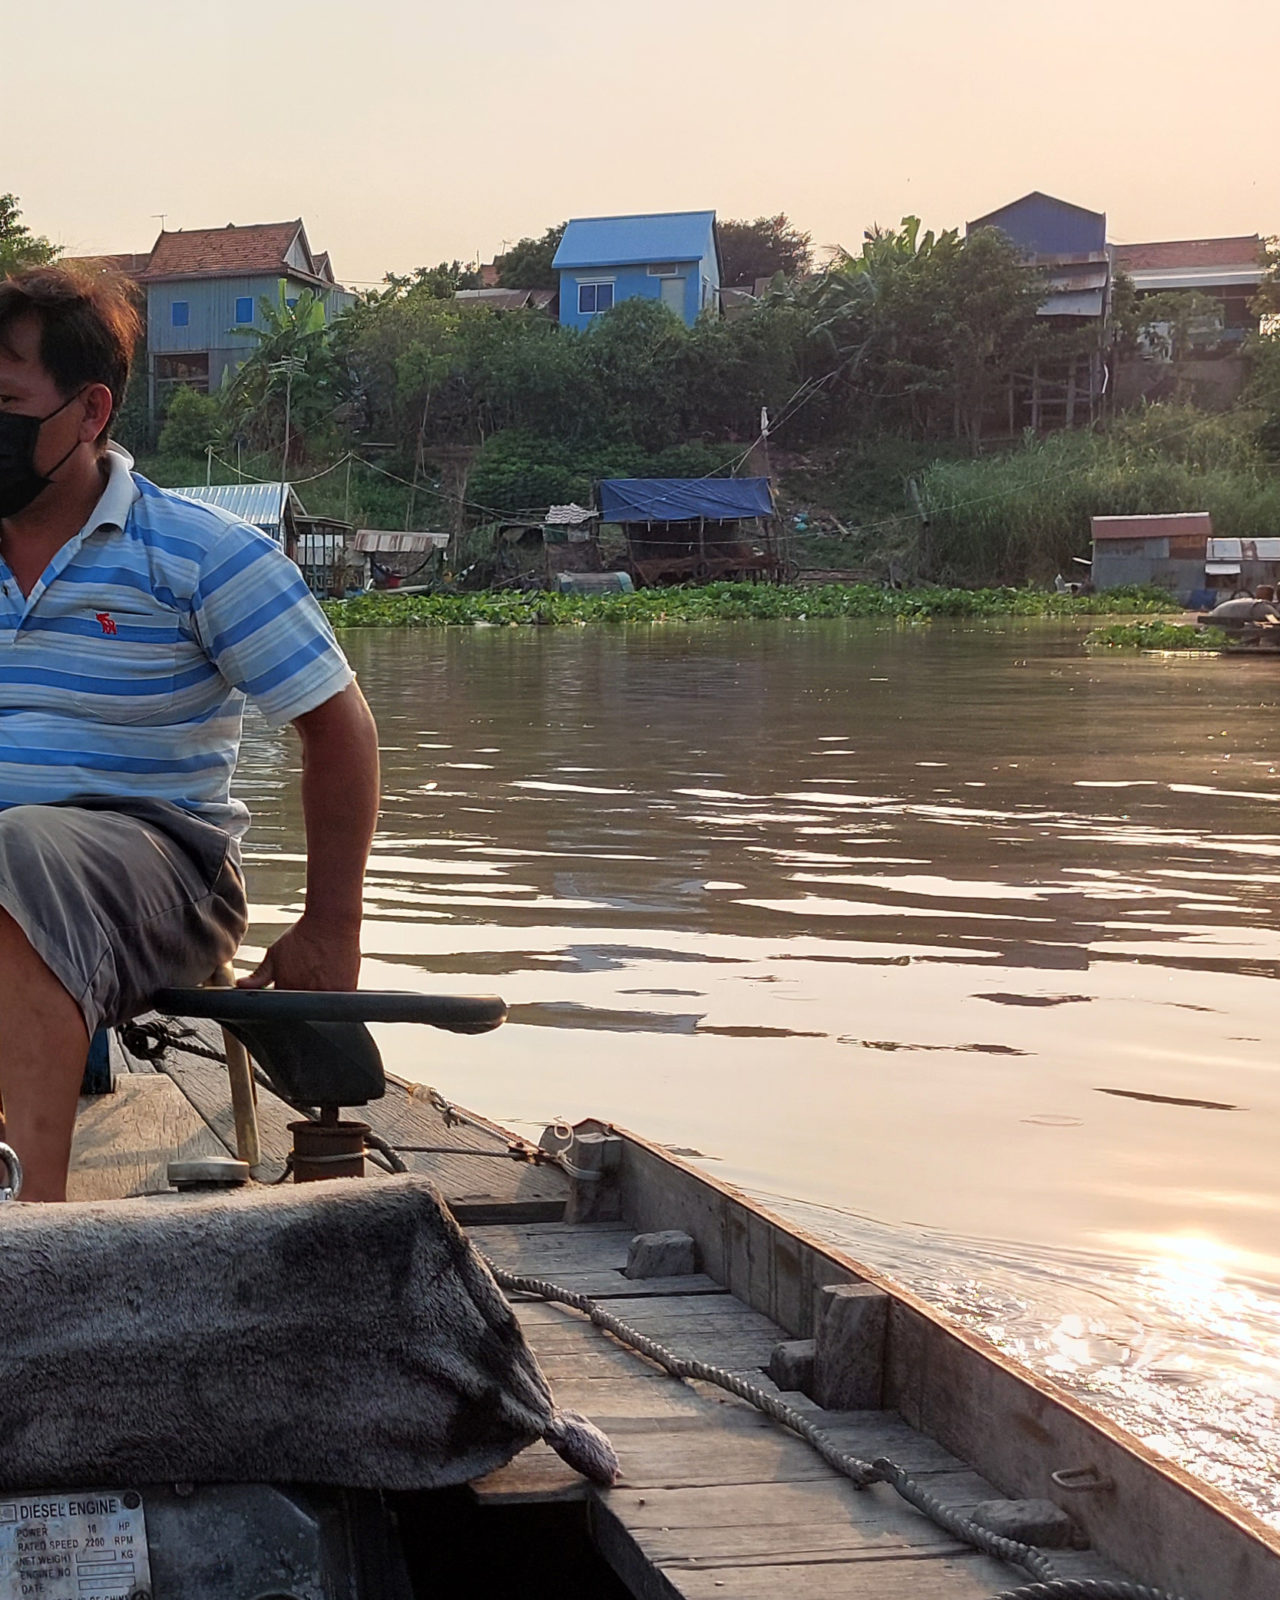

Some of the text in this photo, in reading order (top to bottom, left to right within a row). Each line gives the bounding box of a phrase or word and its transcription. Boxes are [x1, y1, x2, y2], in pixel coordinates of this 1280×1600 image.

[20, 1503, 66, 1519] DIESEL
[69, 1499, 117, 1516] ENGINE
[16, 1527, 48, 1538] POWER
[118, 1521, 130, 1531] HP
[17, 1535, 133, 1552] RATED SPEED 2200 RPM
[121, 1549, 134, 1559] KG
[20, 1569, 55, 1580] ENGINE
[21, 1583, 46, 1595] DATE
